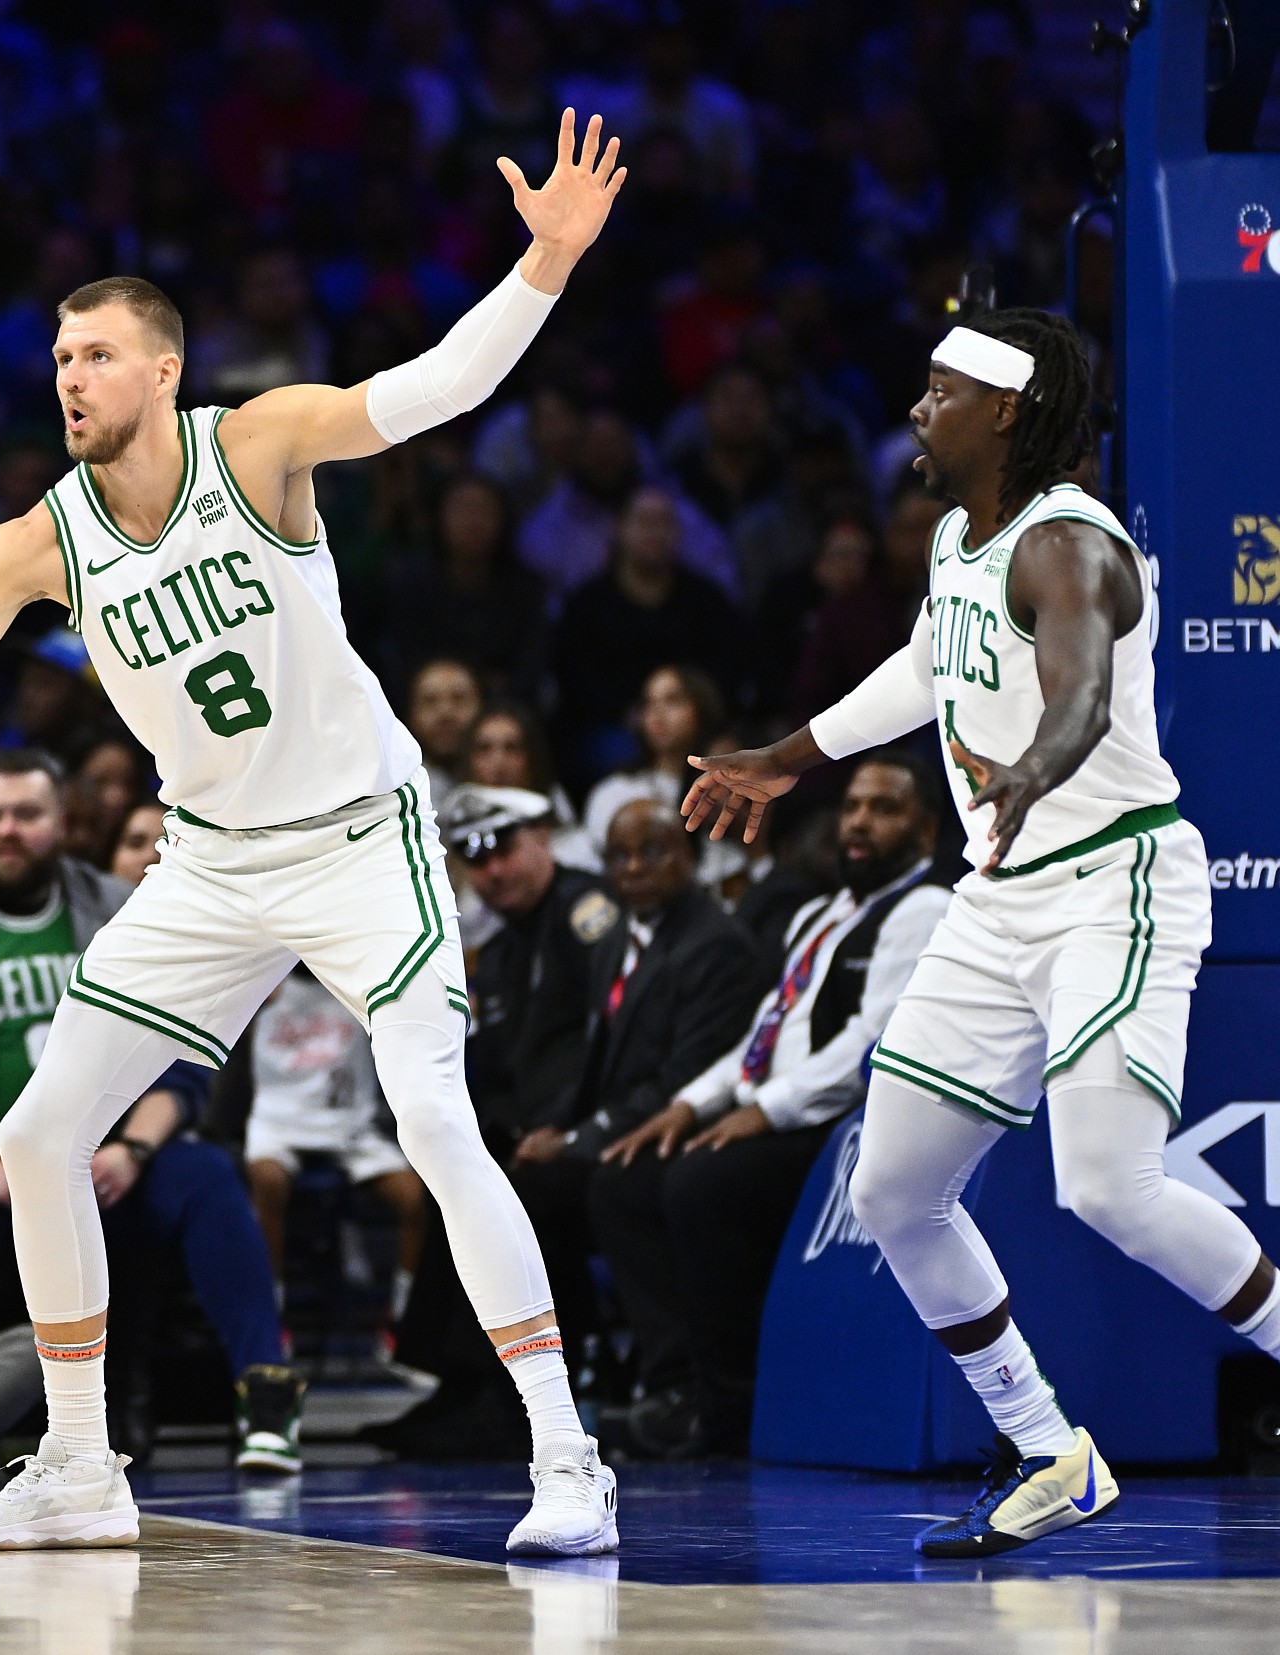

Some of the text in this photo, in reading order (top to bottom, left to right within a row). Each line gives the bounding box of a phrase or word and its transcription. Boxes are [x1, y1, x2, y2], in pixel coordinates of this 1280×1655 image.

[192, 489, 225, 516] VISTA
[199, 505, 229, 528] PRINT
[989, 547, 1012, 563] VIST
[101, 550, 275, 670] CELTICS
[184, 650, 272, 738] 8
